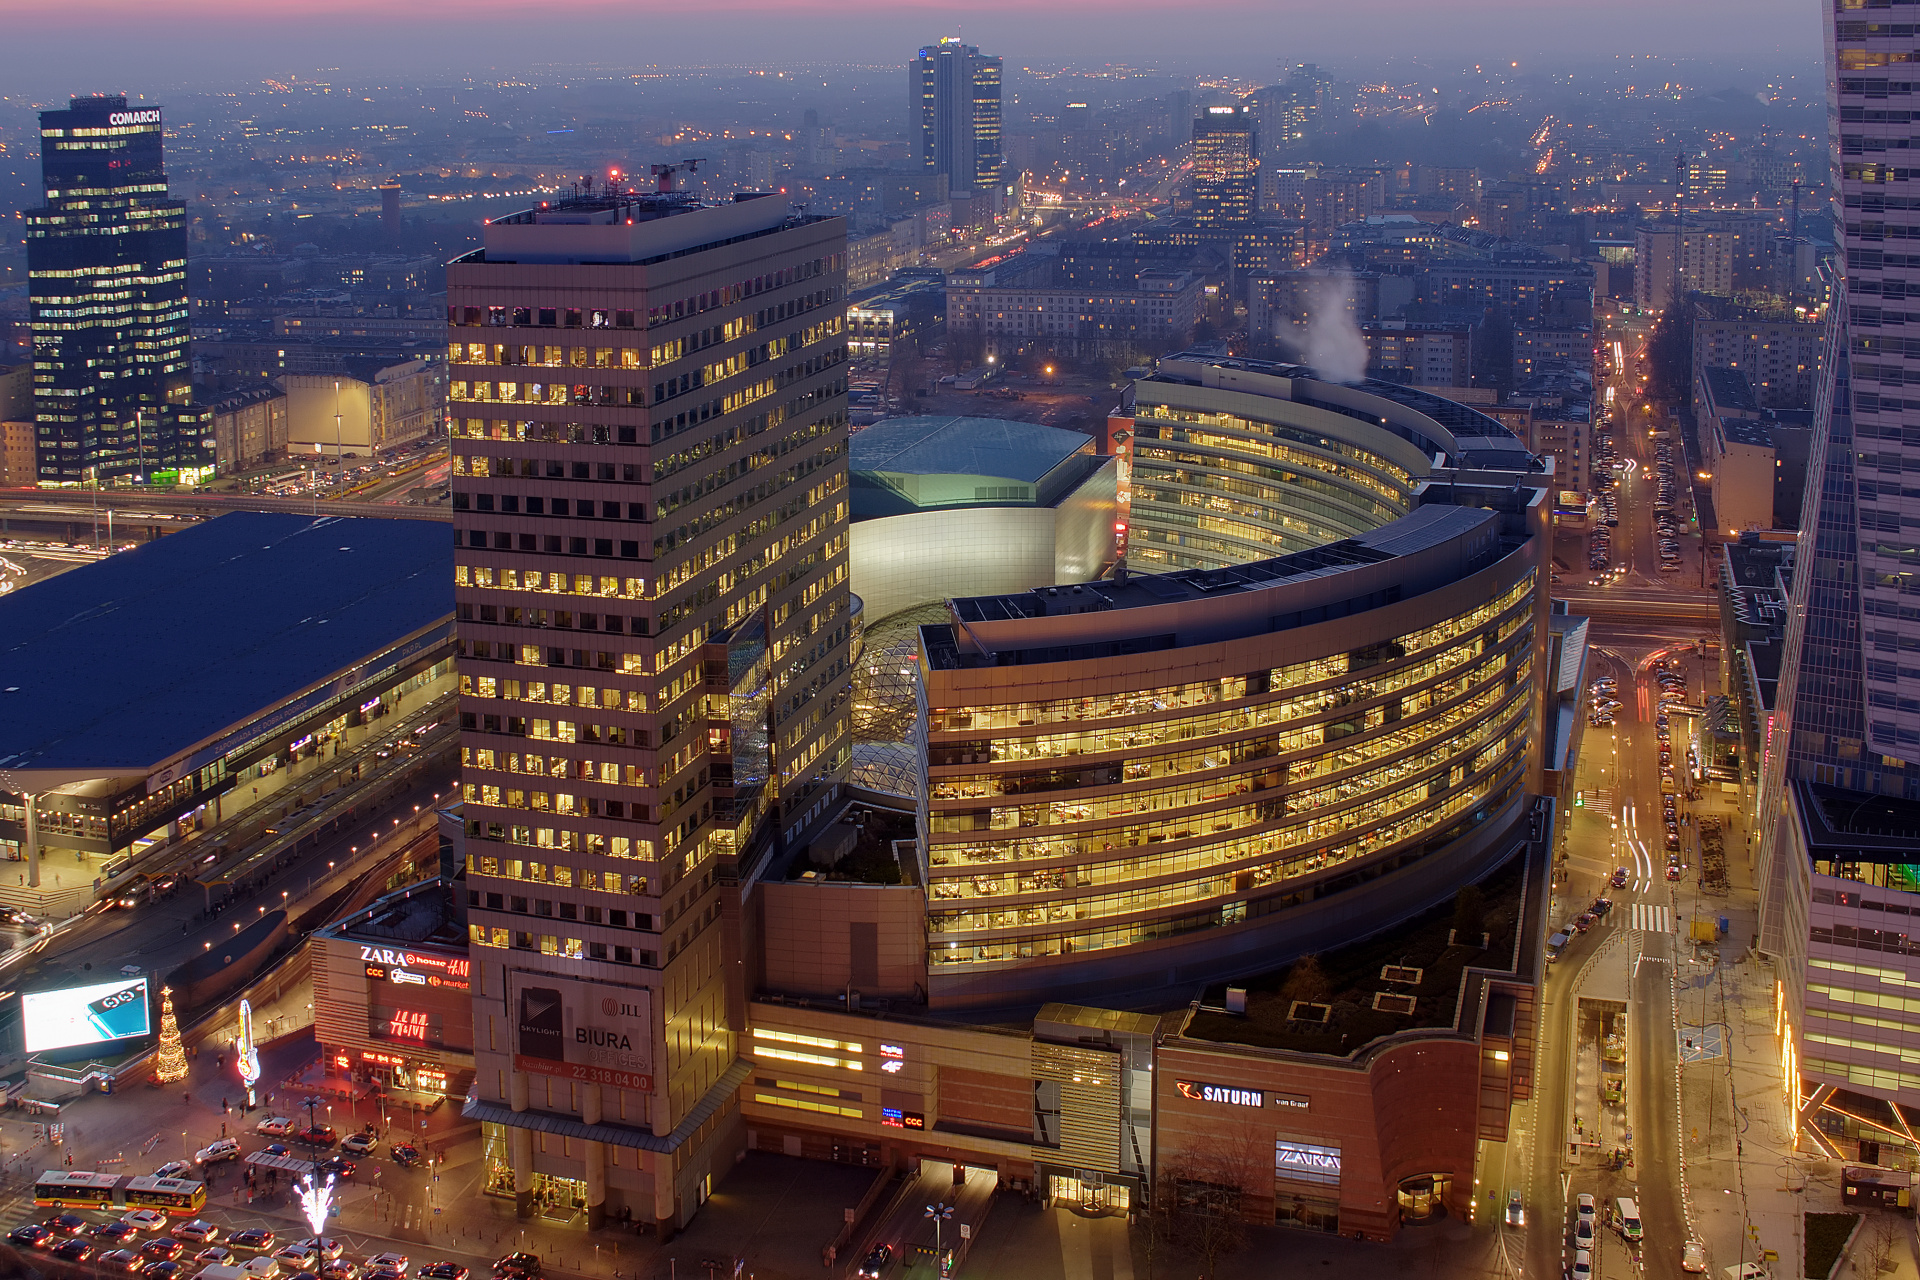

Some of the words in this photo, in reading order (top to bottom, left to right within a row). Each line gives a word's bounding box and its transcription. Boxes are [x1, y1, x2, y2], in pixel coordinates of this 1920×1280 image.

[109, 110, 160, 126] COMARCH
[215, 730, 251, 754] ZAPOWIADA
[262, 714, 283, 730] DOBRA
[360, 946, 408, 967] ZARA
[416, 957, 446, 967] house
[366, 967, 384, 977] CCC
[447, 959, 470, 977] H&M
[442, 979, 469, 989] market
[619, 1003, 641, 1017] JLL
[390, 1010, 427, 1040] H&M
[520, 1025, 560, 1036] SKYLIGHT
[575, 1027, 632, 1051] BIURA
[587, 1047, 646, 1069] OFFICES
[881, 1060, 904, 1074] 4F
[572, 1065, 586, 1079] 22
[590, 1068, 611, 1083] 318
[614, 1072, 629, 1086] 04
[632, 1075, 647, 1089] 00
[1203, 1086, 1262, 1108] SATURN
[1275, 1098, 1289, 1107] van
[1290, 1099, 1309, 1109] Graaf
[905, 1117, 922, 1127] CCC
[1279, 1145, 1341, 1169] ZARA
